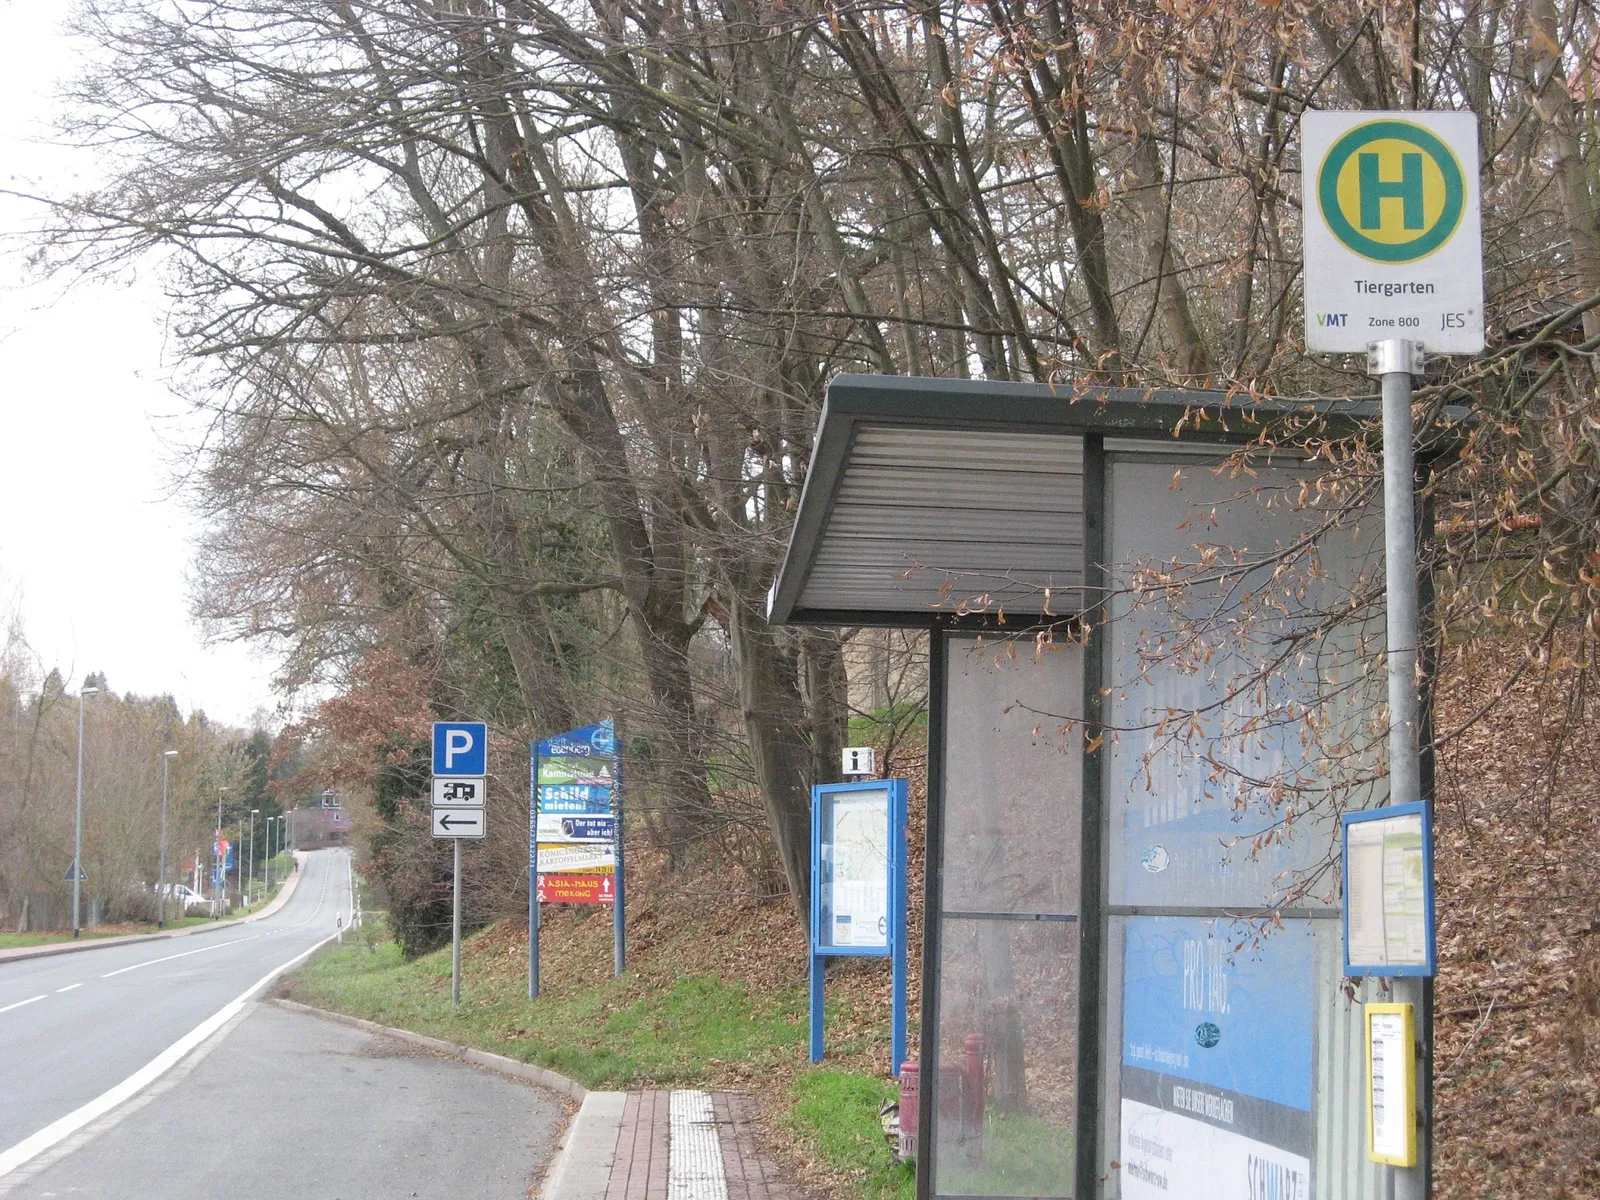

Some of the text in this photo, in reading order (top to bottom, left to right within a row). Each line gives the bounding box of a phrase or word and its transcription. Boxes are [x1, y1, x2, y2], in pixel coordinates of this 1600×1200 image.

[1358, 152, 1425, 230] H
[1354, 280, 1435, 297] Tiergarten
[1316, 313, 1348, 327] VMT
[1368, 317, 1420, 327] Zone 800
[1440, 312, 1466, 331] JES
[445, 729, 474, 768] P
[545, 786, 589, 801] Schild
[544, 800, 587, 811] mieten!
[575, 819, 586, 827] Der
[539, 853, 602, 866] KARTOFFELMARKT
